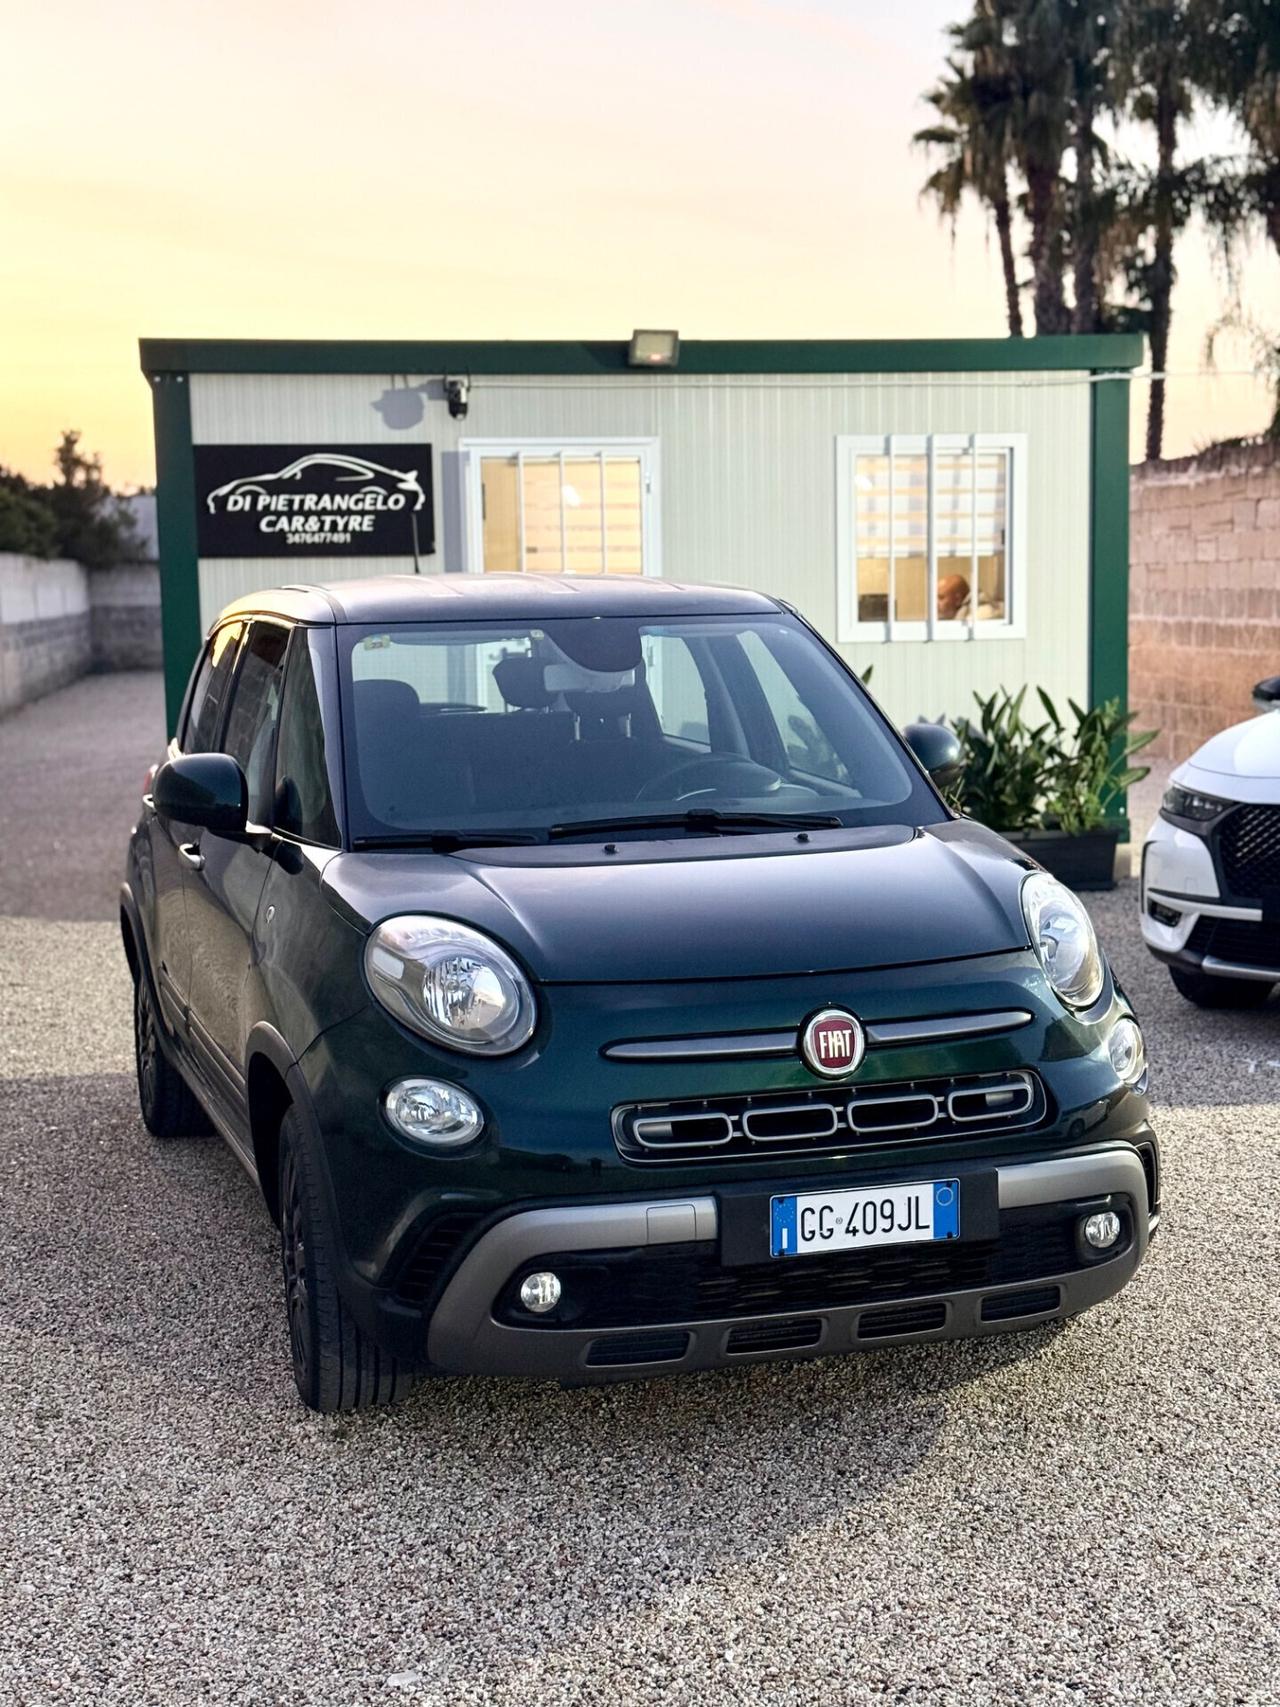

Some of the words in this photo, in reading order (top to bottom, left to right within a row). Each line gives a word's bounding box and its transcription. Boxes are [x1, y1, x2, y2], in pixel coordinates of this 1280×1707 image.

[226, 495, 251, 512] DI
[257, 494, 406, 512] PIETRANGELO
[259, 515, 375, 533] CAR&TYRE
[286, 532, 351, 544] 3476477491
[819, 1030, 852, 1059] FIAT
